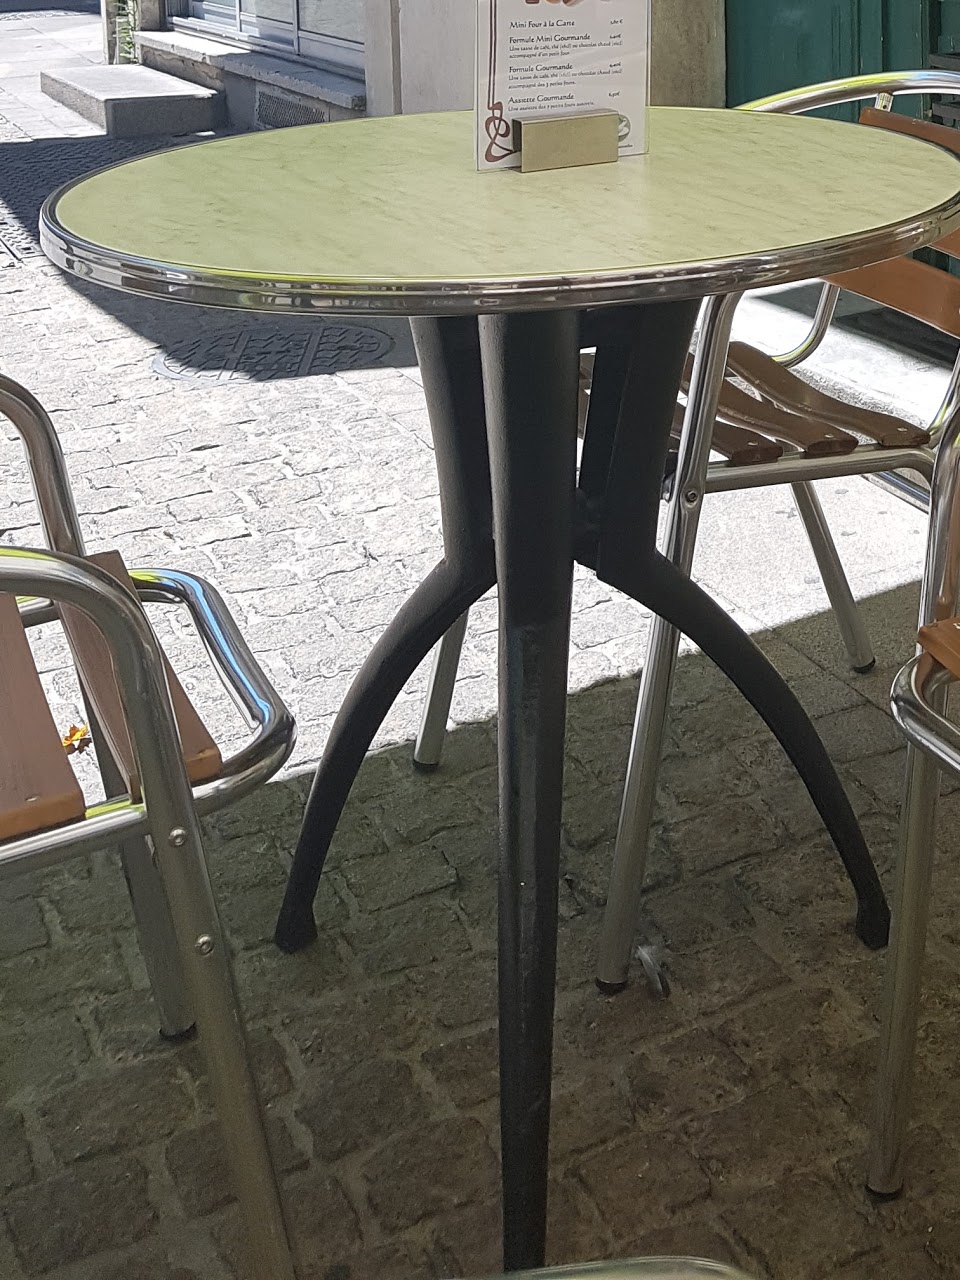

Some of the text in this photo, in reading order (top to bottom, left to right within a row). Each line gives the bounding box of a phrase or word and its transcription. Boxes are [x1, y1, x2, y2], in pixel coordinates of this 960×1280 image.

[510, 21, 526, 29] Mini
[509, 36, 534, 44] Formule
[554, 33, 590, 41] Gourmande
[535, 63, 573, 71] Gourmande
[537, 93, 574, 101] Gourmande
